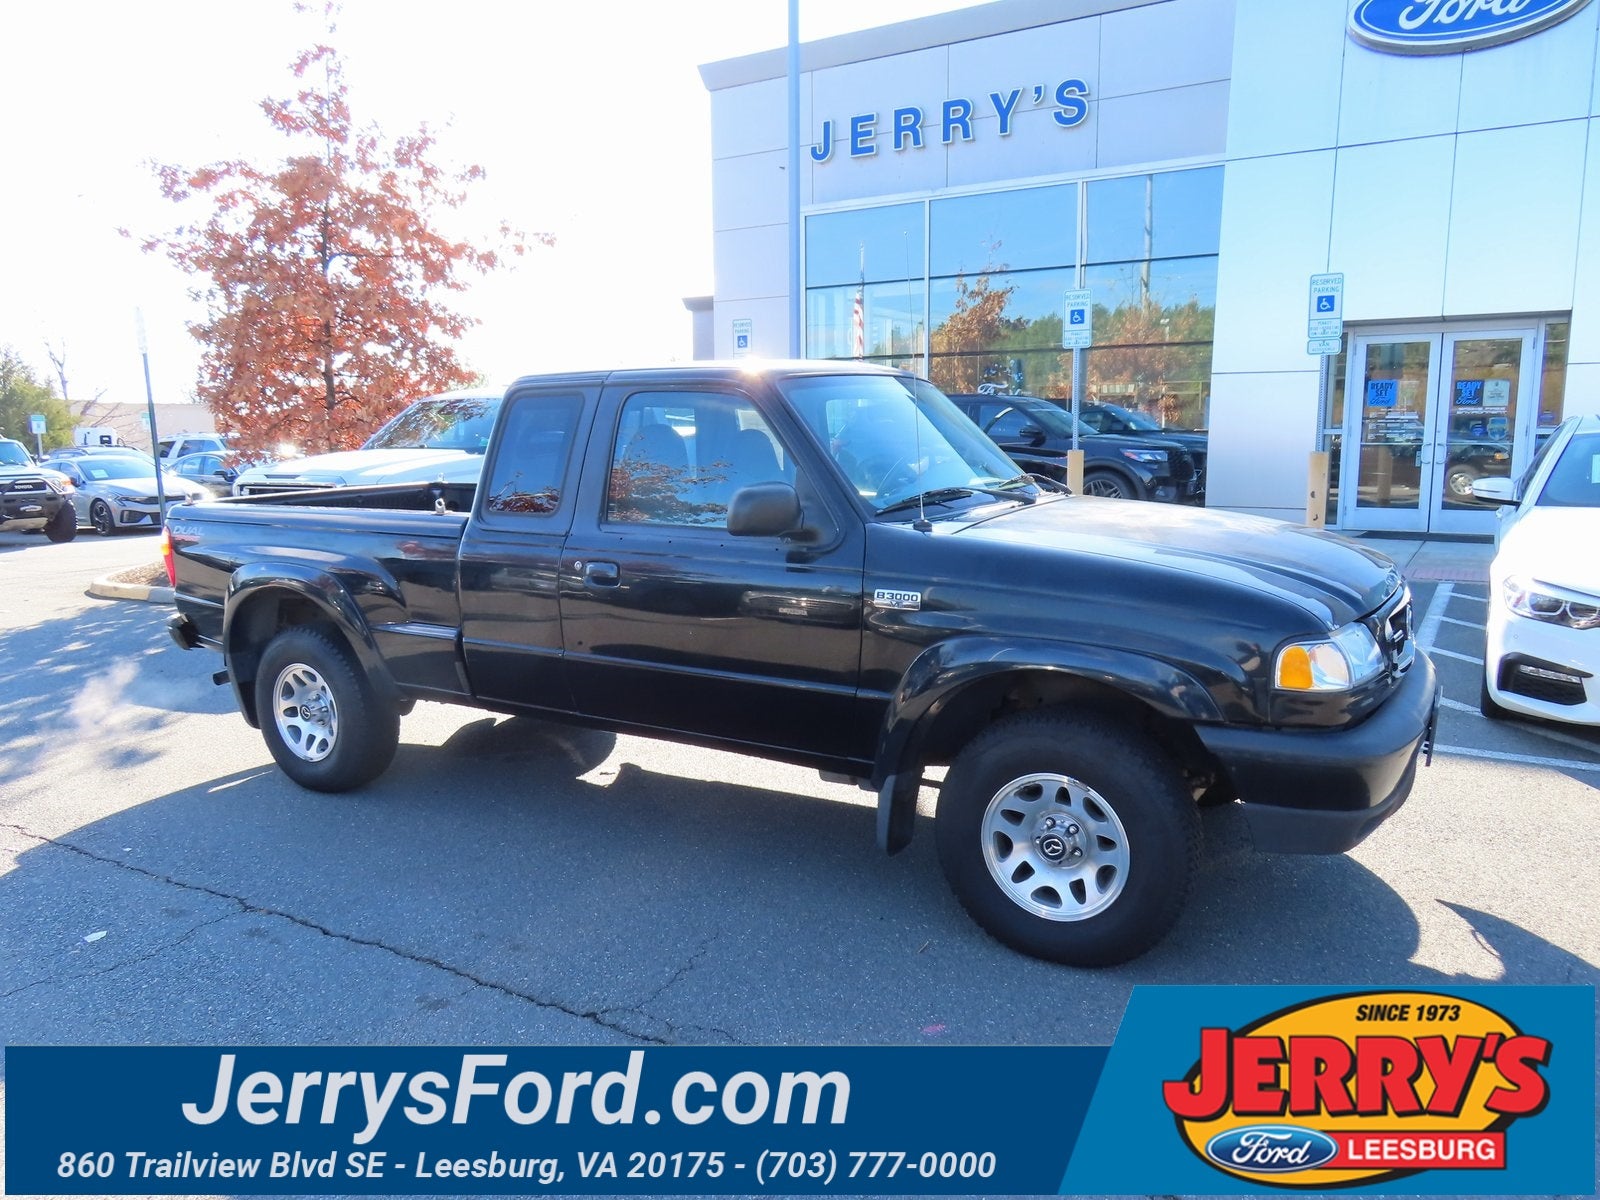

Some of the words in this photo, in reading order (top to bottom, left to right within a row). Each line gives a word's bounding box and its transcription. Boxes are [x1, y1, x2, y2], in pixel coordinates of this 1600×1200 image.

[810, 78, 1090, 163] JERRY'S
[1370, 382, 1394, 390] READY
[173, 525, 206, 536] DUAL
[876, 591, 919, 602] B3000
